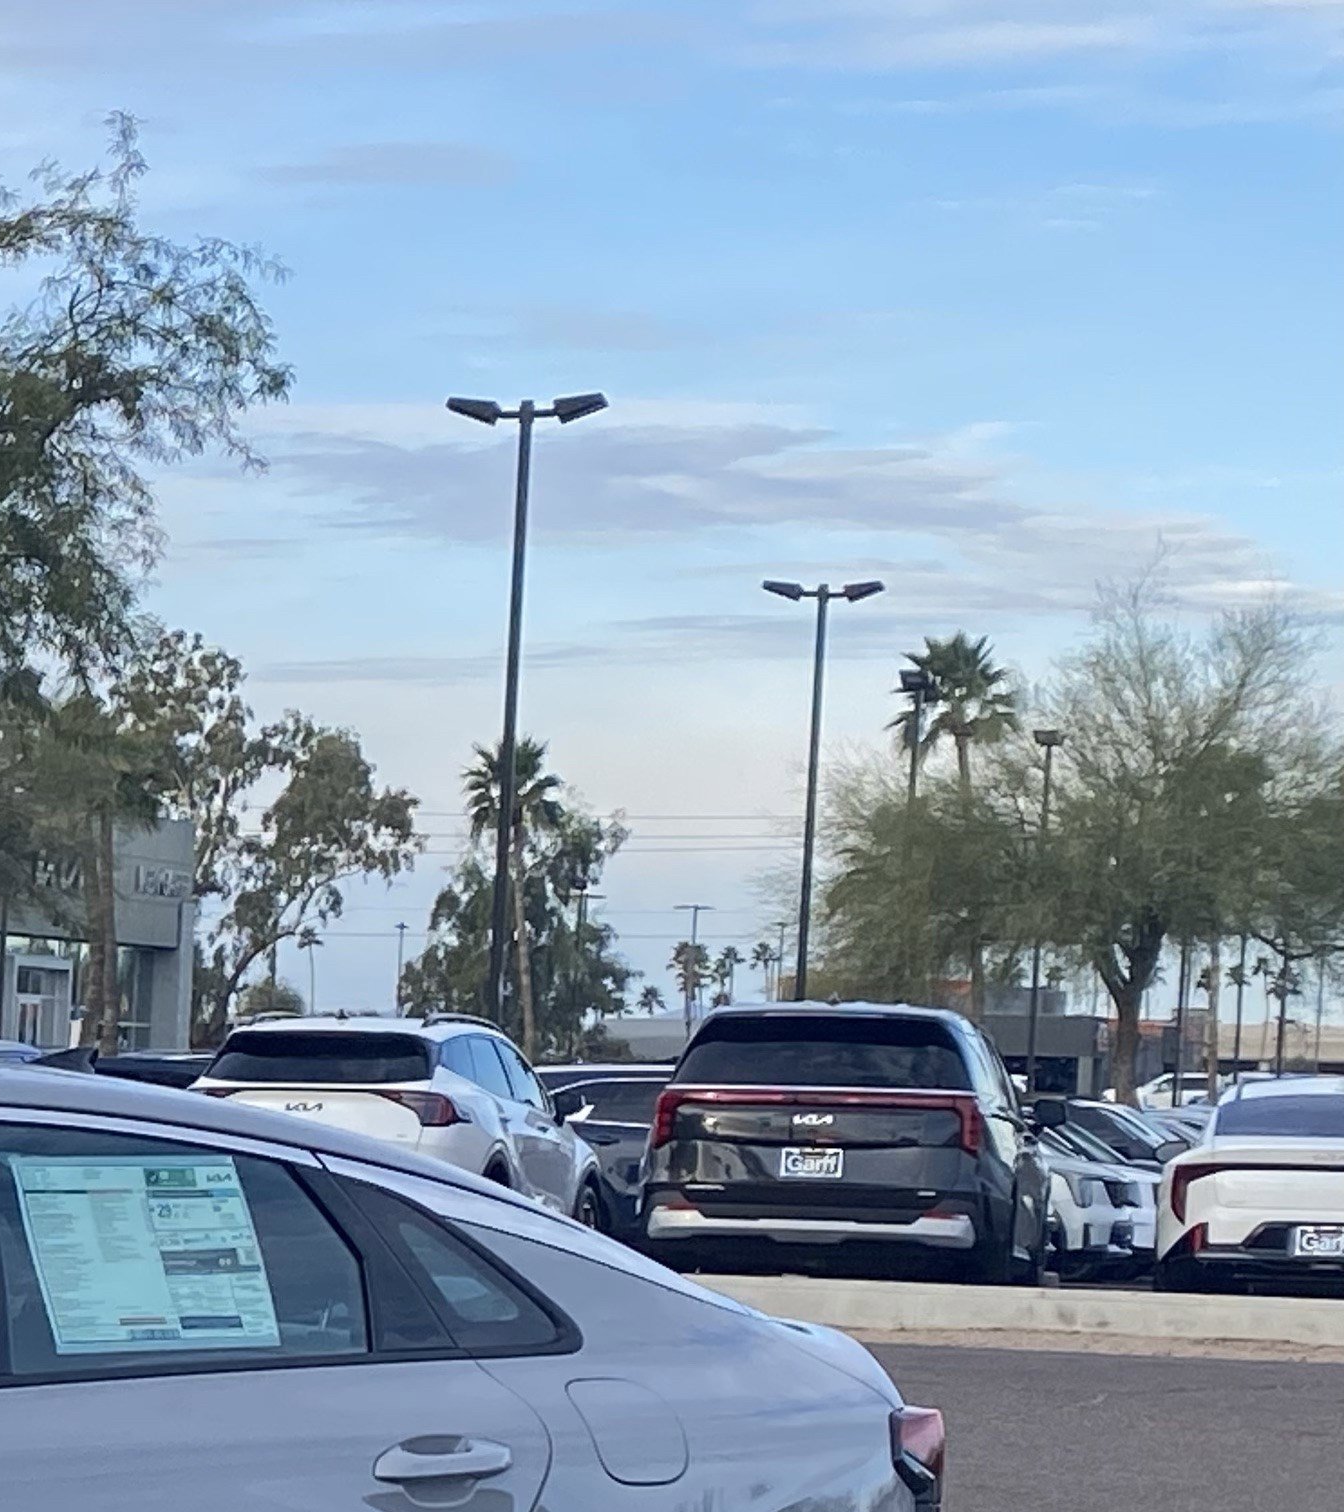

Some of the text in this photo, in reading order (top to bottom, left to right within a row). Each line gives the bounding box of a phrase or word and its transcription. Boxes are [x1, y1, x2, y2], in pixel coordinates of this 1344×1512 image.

[792, 1113, 834, 1125] KIA
[786, 1154, 838, 1173] Garff
[1302, 1233, 1344, 1251] Gar
